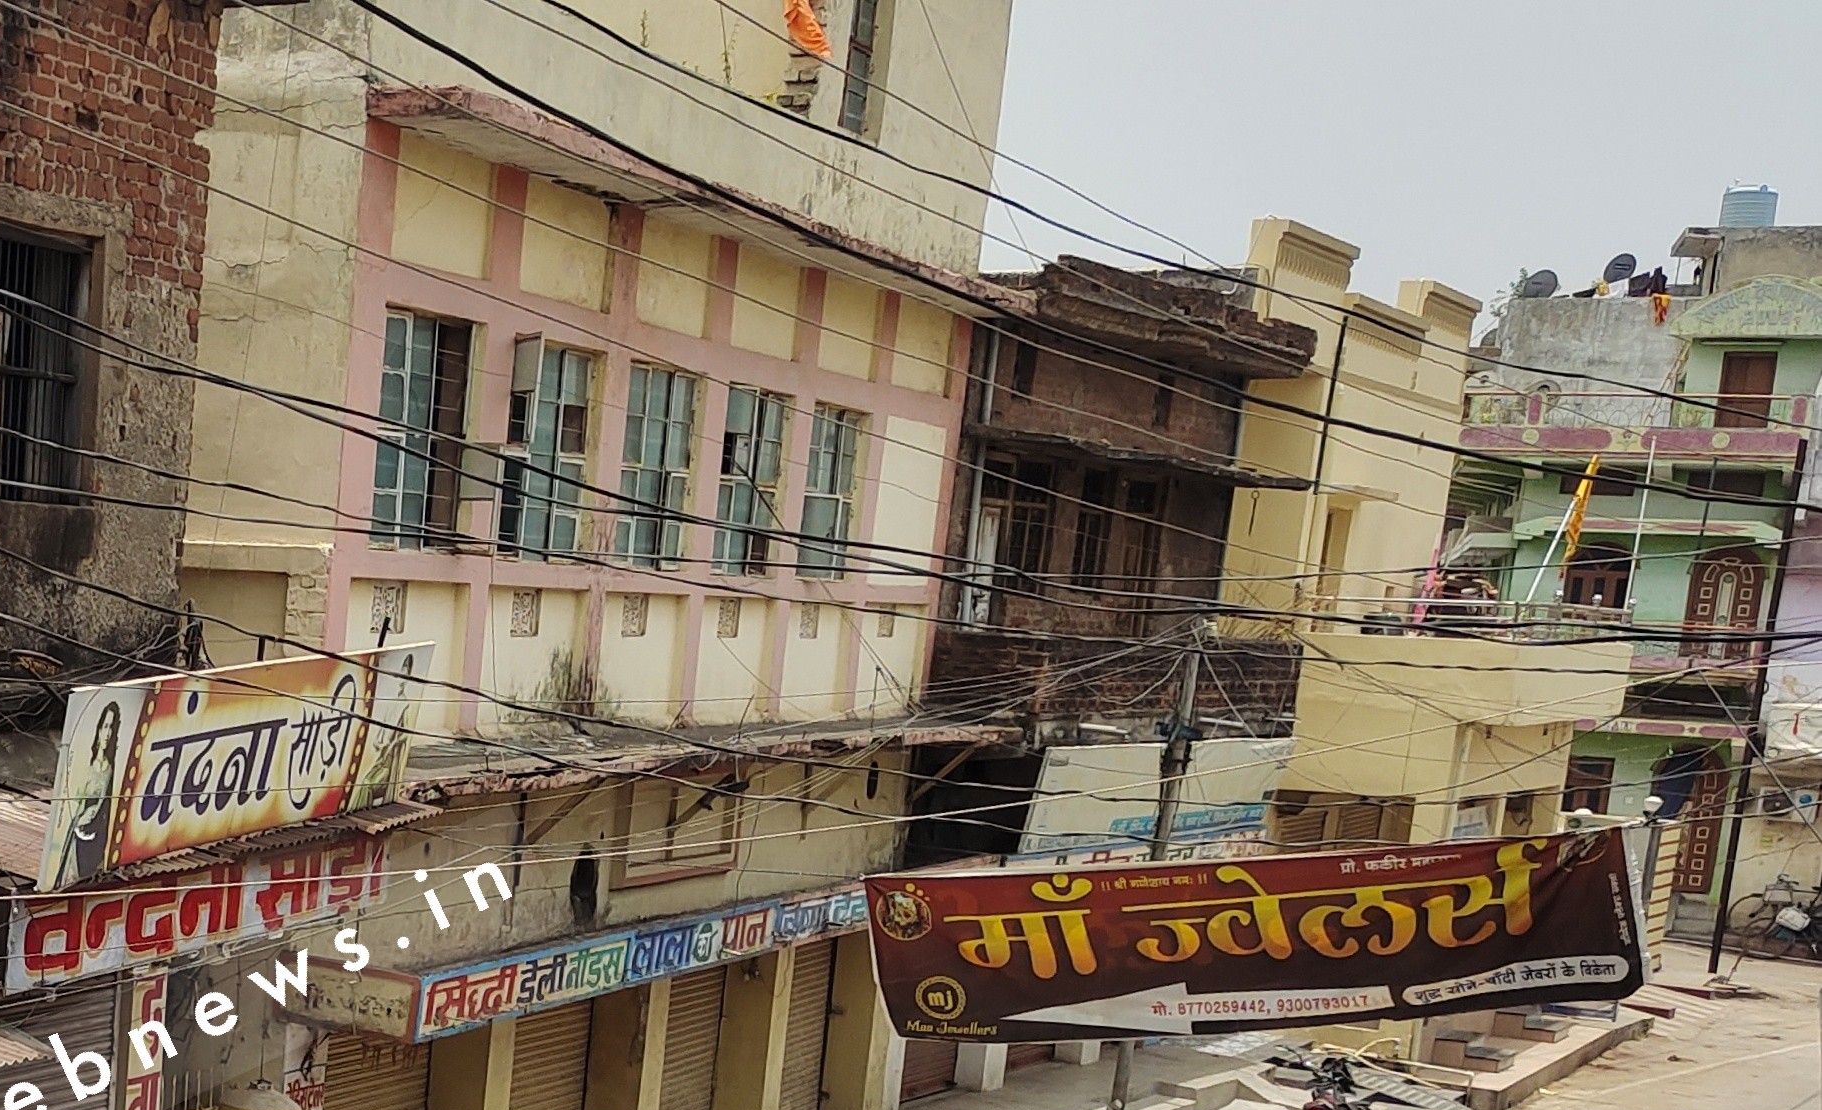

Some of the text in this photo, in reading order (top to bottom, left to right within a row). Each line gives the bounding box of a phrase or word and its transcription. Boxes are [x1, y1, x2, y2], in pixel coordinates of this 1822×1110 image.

[140, 674, 358, 827] वंदना साड़ी
[944, 872, 1097, 979] माँ
[1121, 838, 1550, 963] ज्वेलर्स
